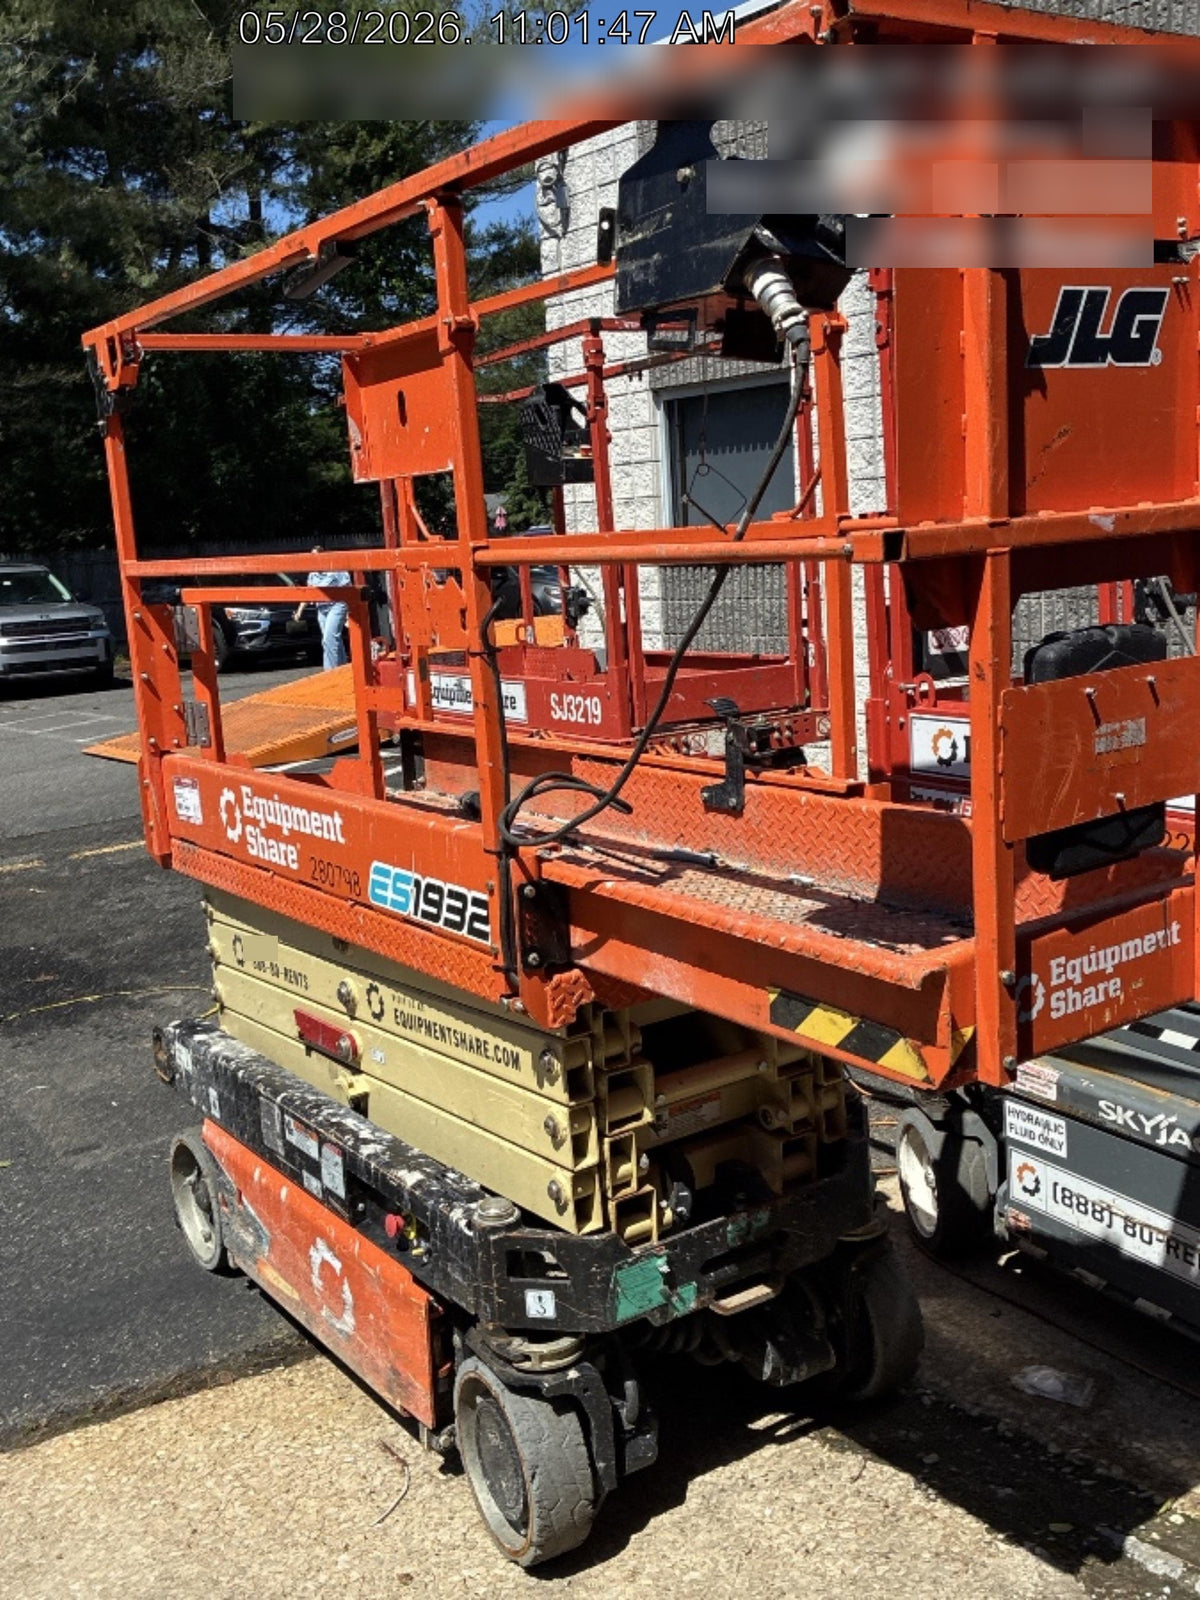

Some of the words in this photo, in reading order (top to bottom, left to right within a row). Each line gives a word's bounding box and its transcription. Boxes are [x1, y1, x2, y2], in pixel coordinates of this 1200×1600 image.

[1025, 285, 1170, 368] JLG
[550, 692, 602, 725] SJ3219
[239, 785, 346, 845] Equipment
[244, 824, 299, 871] Share
[308, 855, 362, 897] 280798
[368, 860, 491, 946] ES1932
[1049, 920, 1182, 988] Equipment
[1050, 976, 1122, 1020] Share
[393, 1008, 522, 1073] EQUIPMENTSHARE.COM
[1007, 1105, 1065, 1136] HYDRAULIC
[1009, 1122, 1036, 1141] FLUID
[1037, 1132, 1064, 1153] ONLY
[1052, 1181, 1115, 1230] (888)
[1123, 1213, 1200, 1270] 80-RE
